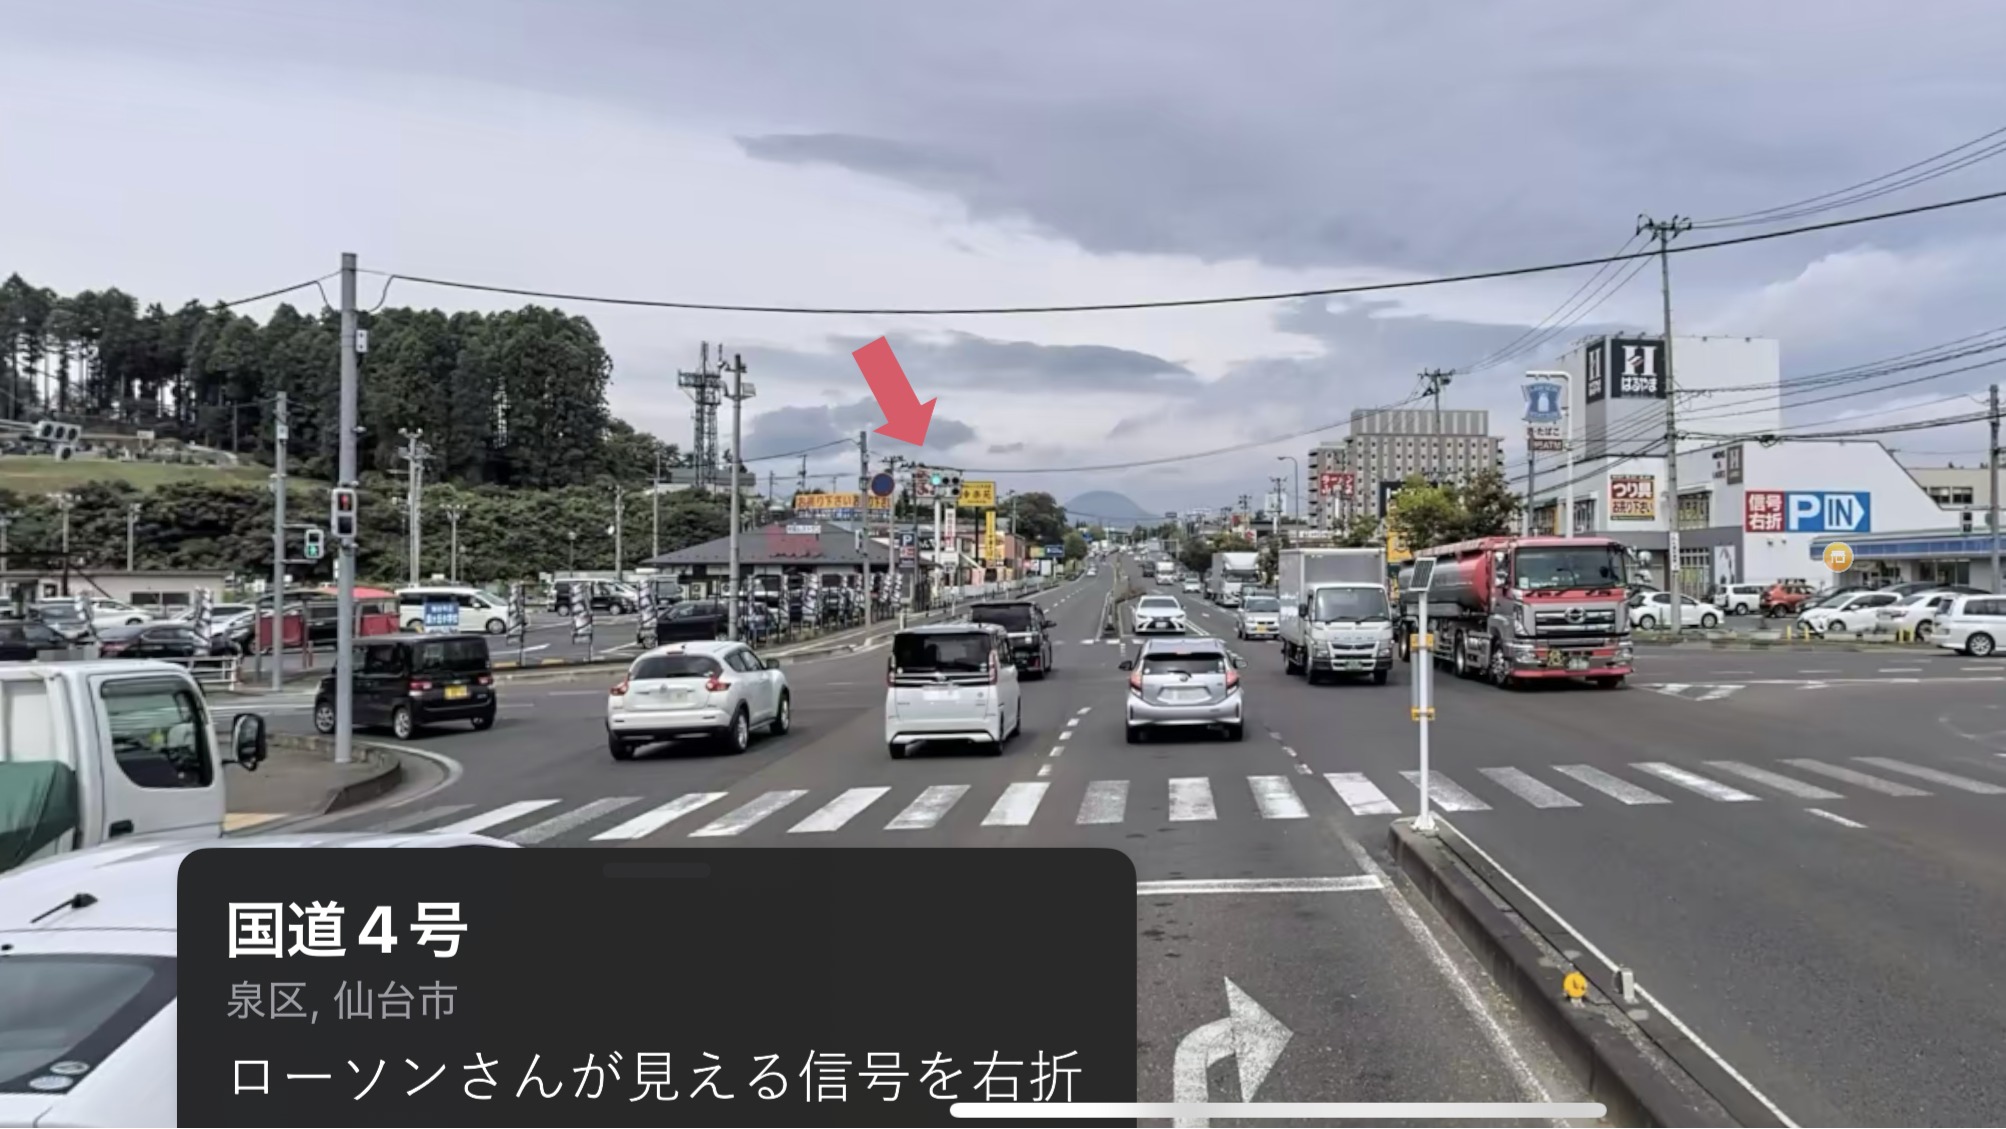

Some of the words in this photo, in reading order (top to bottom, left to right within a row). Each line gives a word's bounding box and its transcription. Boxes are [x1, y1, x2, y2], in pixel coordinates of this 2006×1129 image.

[1621, 345, 1658, 376] H
[1621, 377, 1658, 392] はるやま
[1612, 482, 1653, 498] つり具
[1612, 501, 1653, 514] お売り下さい
[1748, 493, 1783, 512] 信号
[1748, 512, 1783, 530] 右折
[1788, 494, 1821, 531] P
[1828, 498, 1853, 527] IN
[902, 534, 913, 546] P
